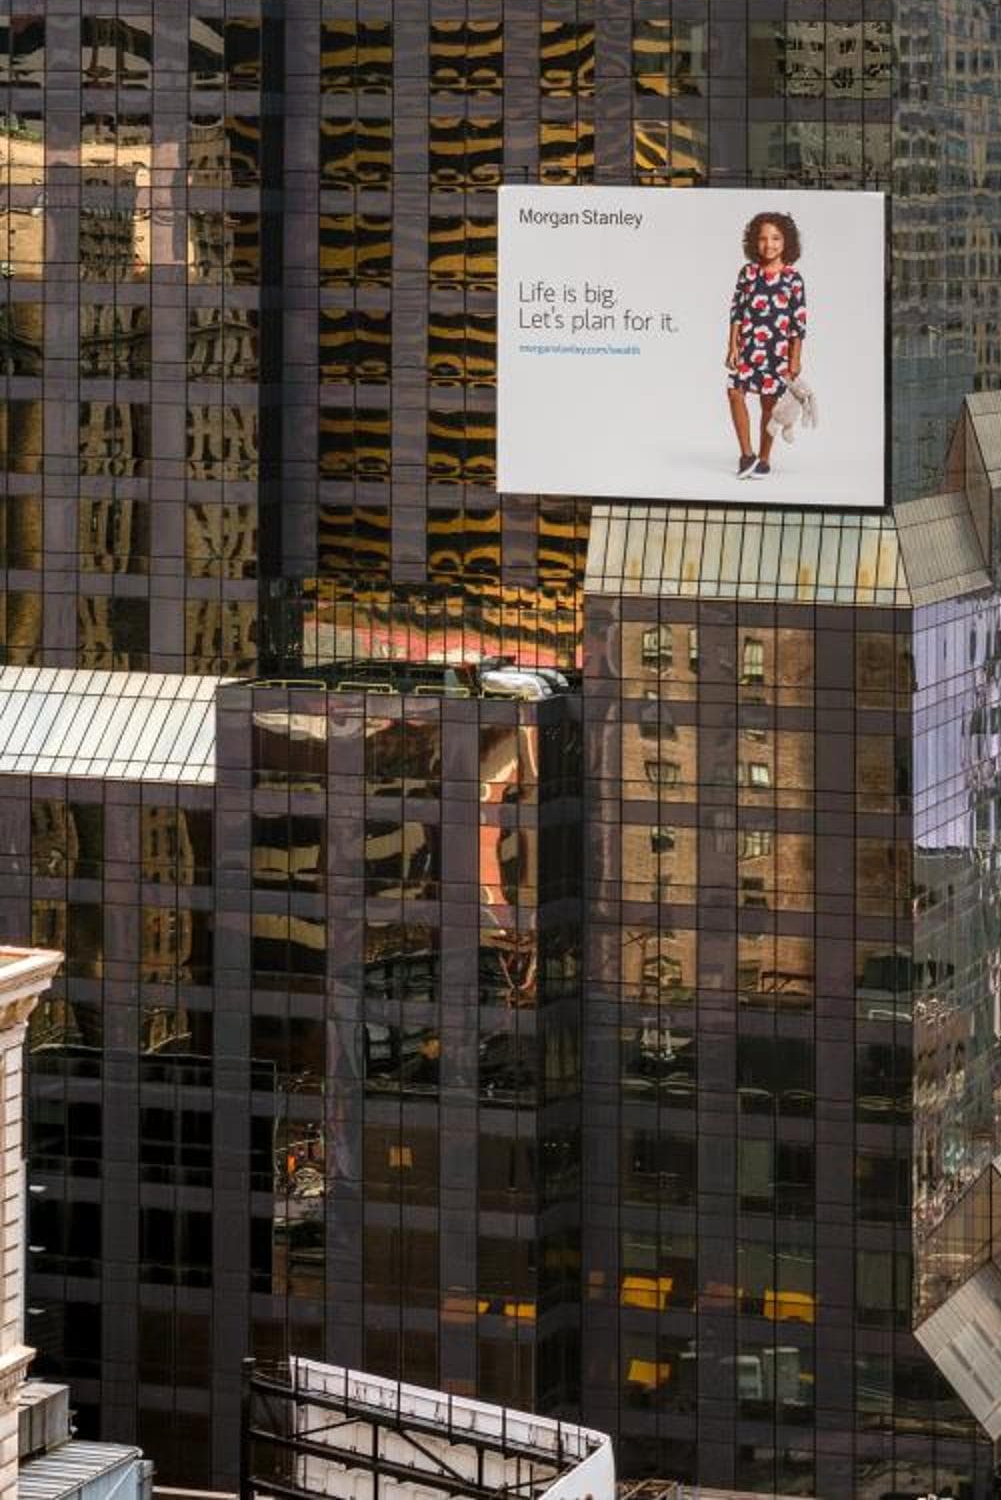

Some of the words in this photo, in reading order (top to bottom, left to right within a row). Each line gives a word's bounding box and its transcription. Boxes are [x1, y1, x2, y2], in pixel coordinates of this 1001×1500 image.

[519, 208, 579, 229] Morgan
[581, 209, 643, 230] Stanley
[519, 281, 556, 303] Life
[563, 284, 577, 303] is
[519, 305, 565, 329] Let's
[571, 307, 616, 334] plan
[623, 309, 653, 332] for
